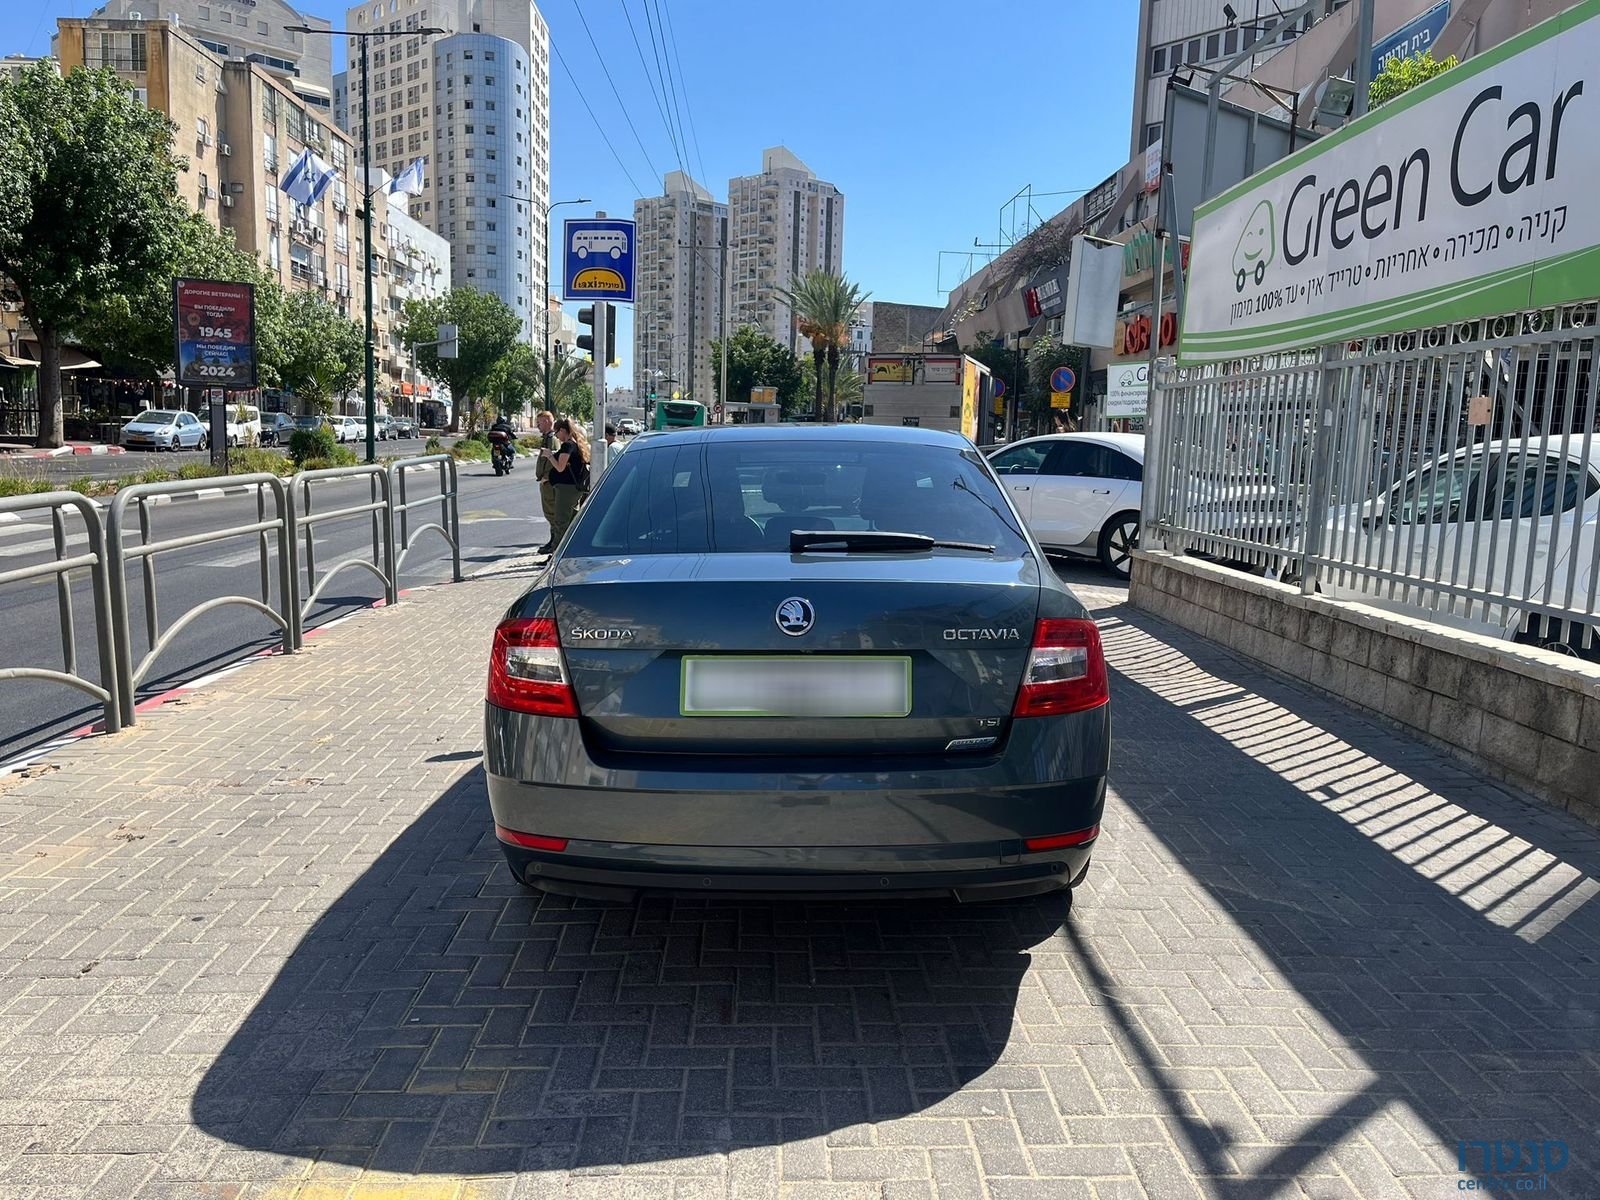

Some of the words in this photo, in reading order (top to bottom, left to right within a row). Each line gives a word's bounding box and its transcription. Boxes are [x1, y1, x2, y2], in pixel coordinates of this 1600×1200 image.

[1412, 29, 1430, 50] בית
[1283, 147, 1430, 266] Green
[1450, 80, 1583, 207] Car
[1519, 205, 1567, 244] קניה
[1445, 224, 1499, 262] מכירה
[1374, 244, 1430, 281] אחריות
[578, 276, 597, 288] taxi
[597, 281, 620, 289] מונית
[1328, 264, 1361, 292] טרייד
[184, 289, 210, 297] ДОРОГИЕ
[211, 291, 241, 299] ВЕТЕРАНЫ
[1286, 284, 1298, 304] עד
[1307, 275, 1324, 304] אין
[1255, 288, 1282, 313] 100%
[1230, 298, 1252, 325] מימון
[199, 326, 232, 339] 1945
[200, 366, 236, 377] 2024
[571, 626, 633, 640] ŠKODA
[943, 628, 1020, 640] OCTAVIA
[977, 718, 1000, 727] TSI
